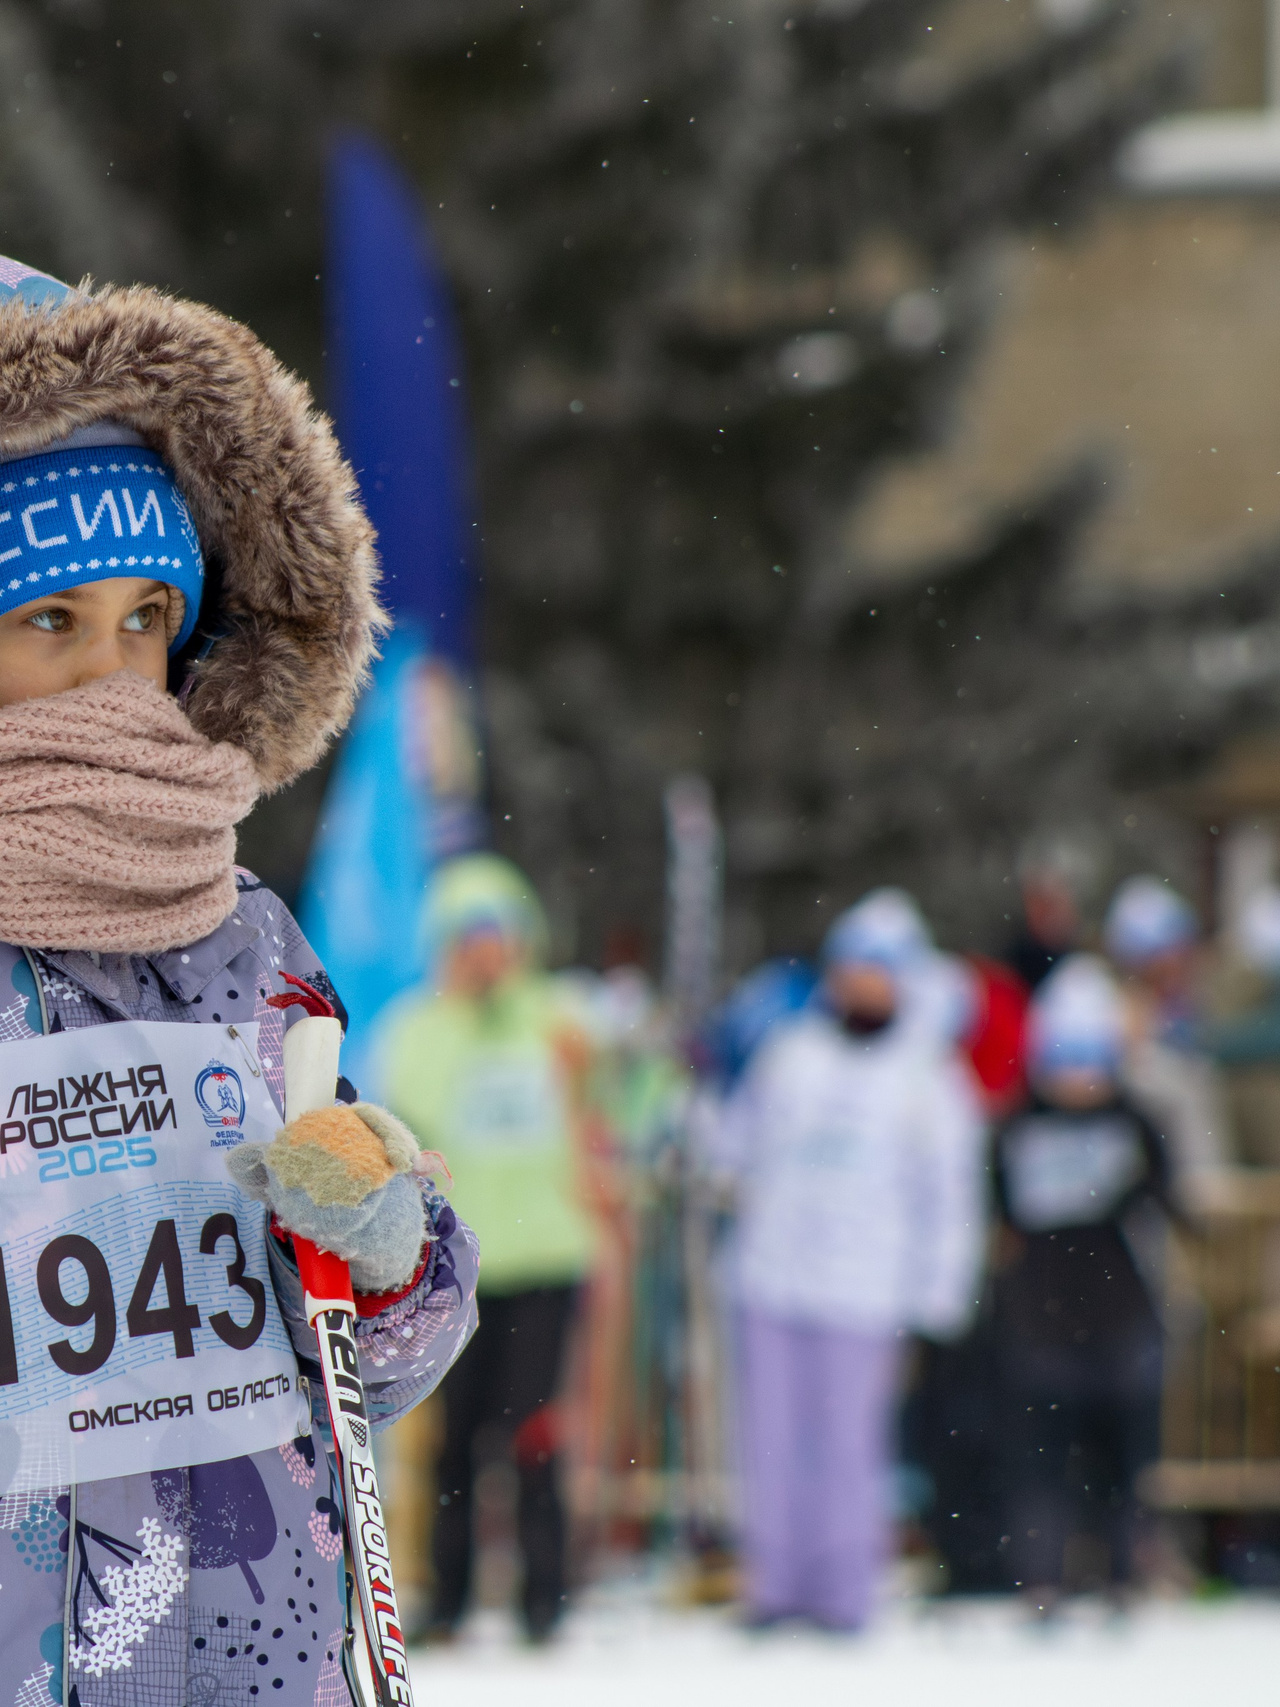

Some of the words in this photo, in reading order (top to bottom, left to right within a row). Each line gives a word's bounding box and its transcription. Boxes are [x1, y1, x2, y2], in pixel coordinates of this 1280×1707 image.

[6, 1063, 168, 1118] ЛЫЖНЯ
[0, 1097, 178, 1155] РОССИИ
[37, 1136, 158, 1184] 2025
[68, 1394, 194, 1433] ОМСКАЯ
[207, 1373, 291, 1413] ОБЛАСТЬ
